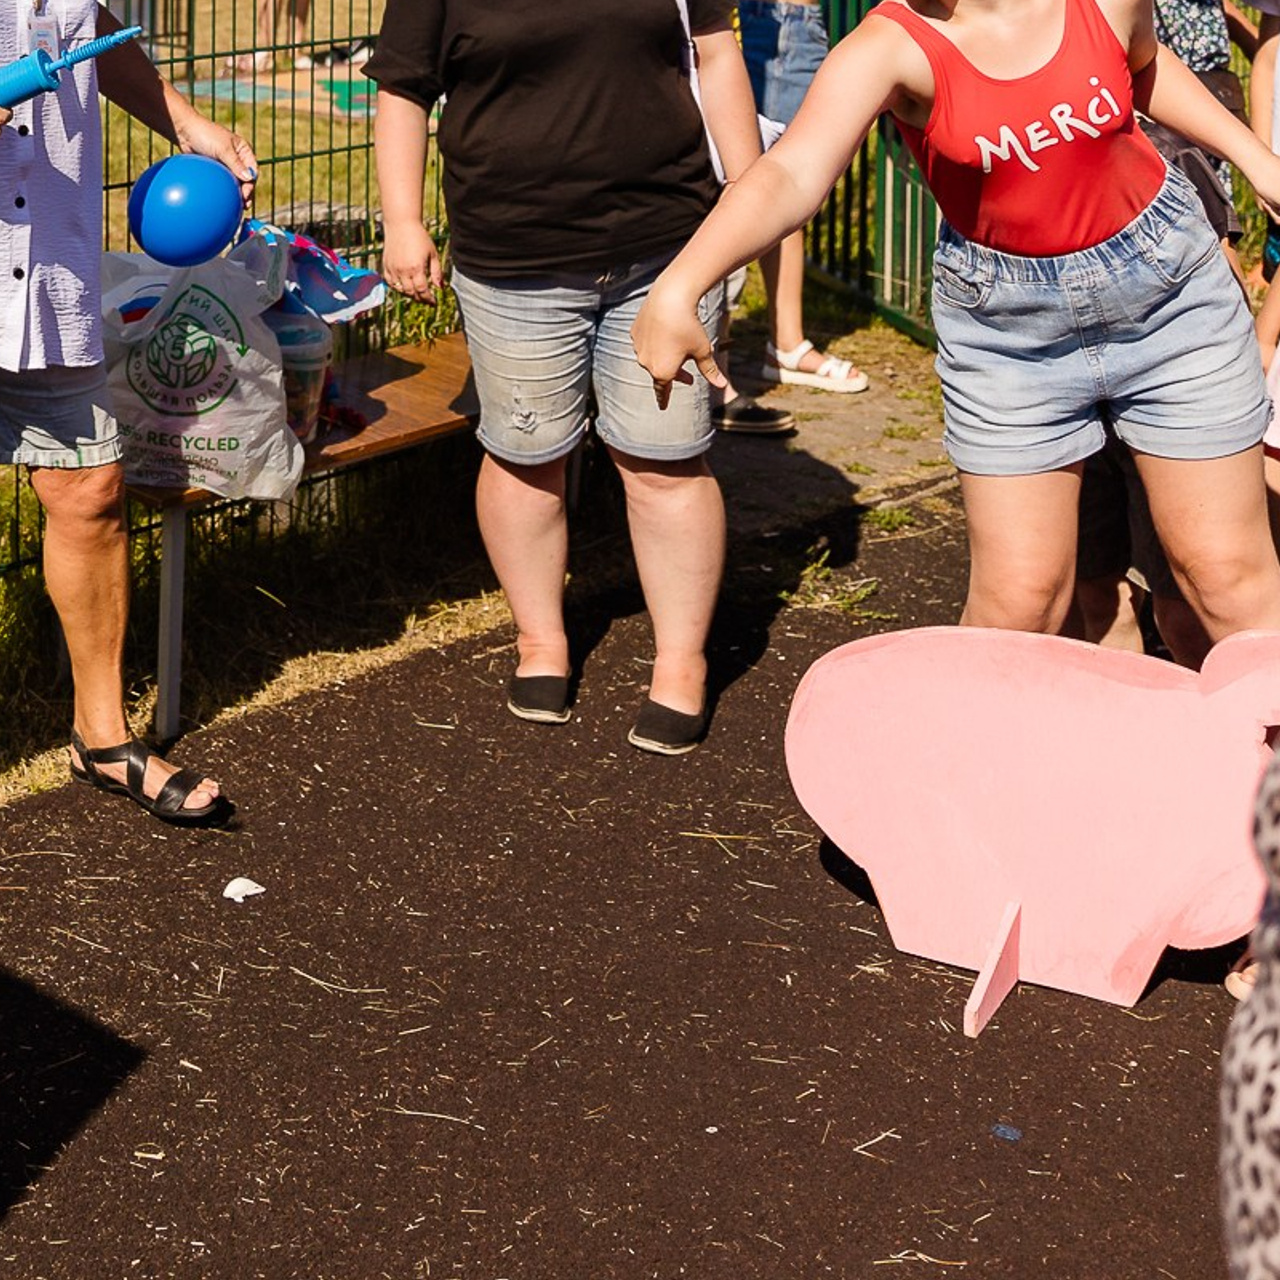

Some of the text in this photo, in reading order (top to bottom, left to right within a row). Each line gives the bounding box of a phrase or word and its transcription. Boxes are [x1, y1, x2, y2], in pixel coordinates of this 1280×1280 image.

[169, 336, 186, 360] 5
[185, 363, 234, 407] ПОЛЬЗА
[147, 430, 240, 452] RECYCLED
